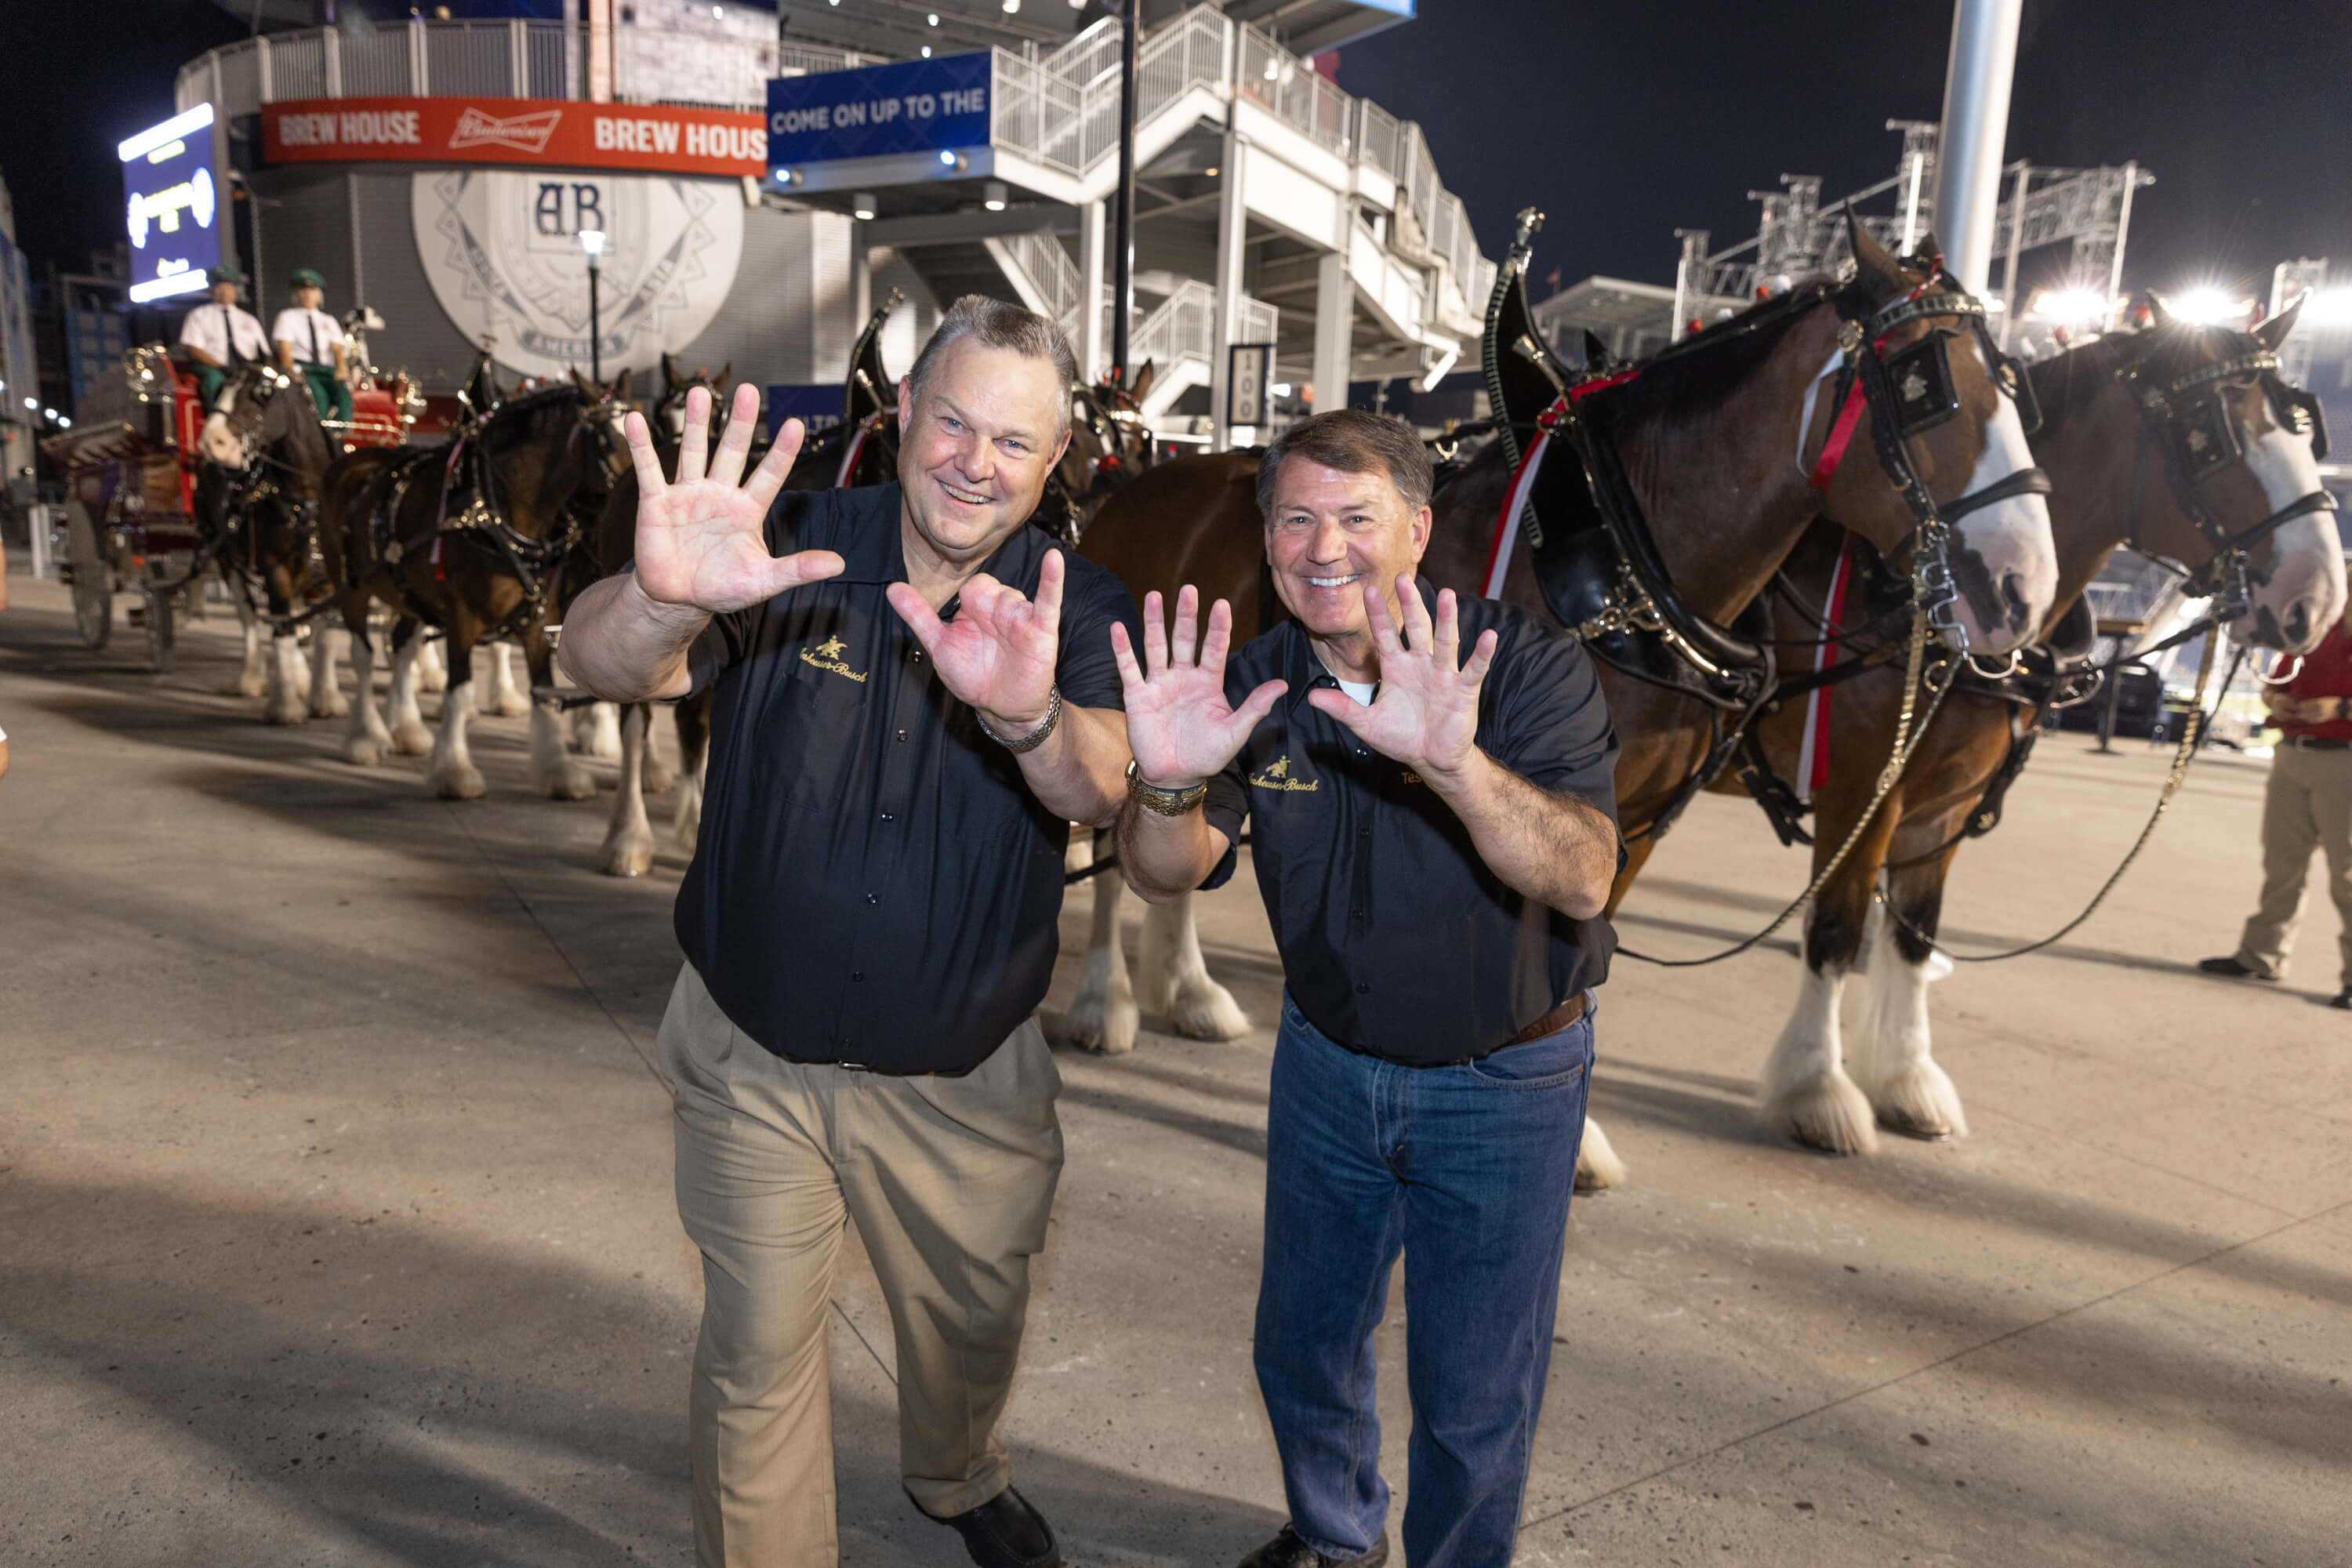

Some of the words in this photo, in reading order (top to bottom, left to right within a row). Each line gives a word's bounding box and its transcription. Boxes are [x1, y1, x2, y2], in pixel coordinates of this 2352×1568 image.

[278, 114, 337, 146] BREW
[340, 111, 421, 143] HOUSE
[771, 106, 829, 134] COME
[833, 100, 866, 128] ON
[870, 97, 901, 125] UP
[906, 94, 936, 119] TO
[940, 88, 985, 115] THE
[594, 117, 680, 154] BREW
[531, 334, 619, 358] AMERIA
